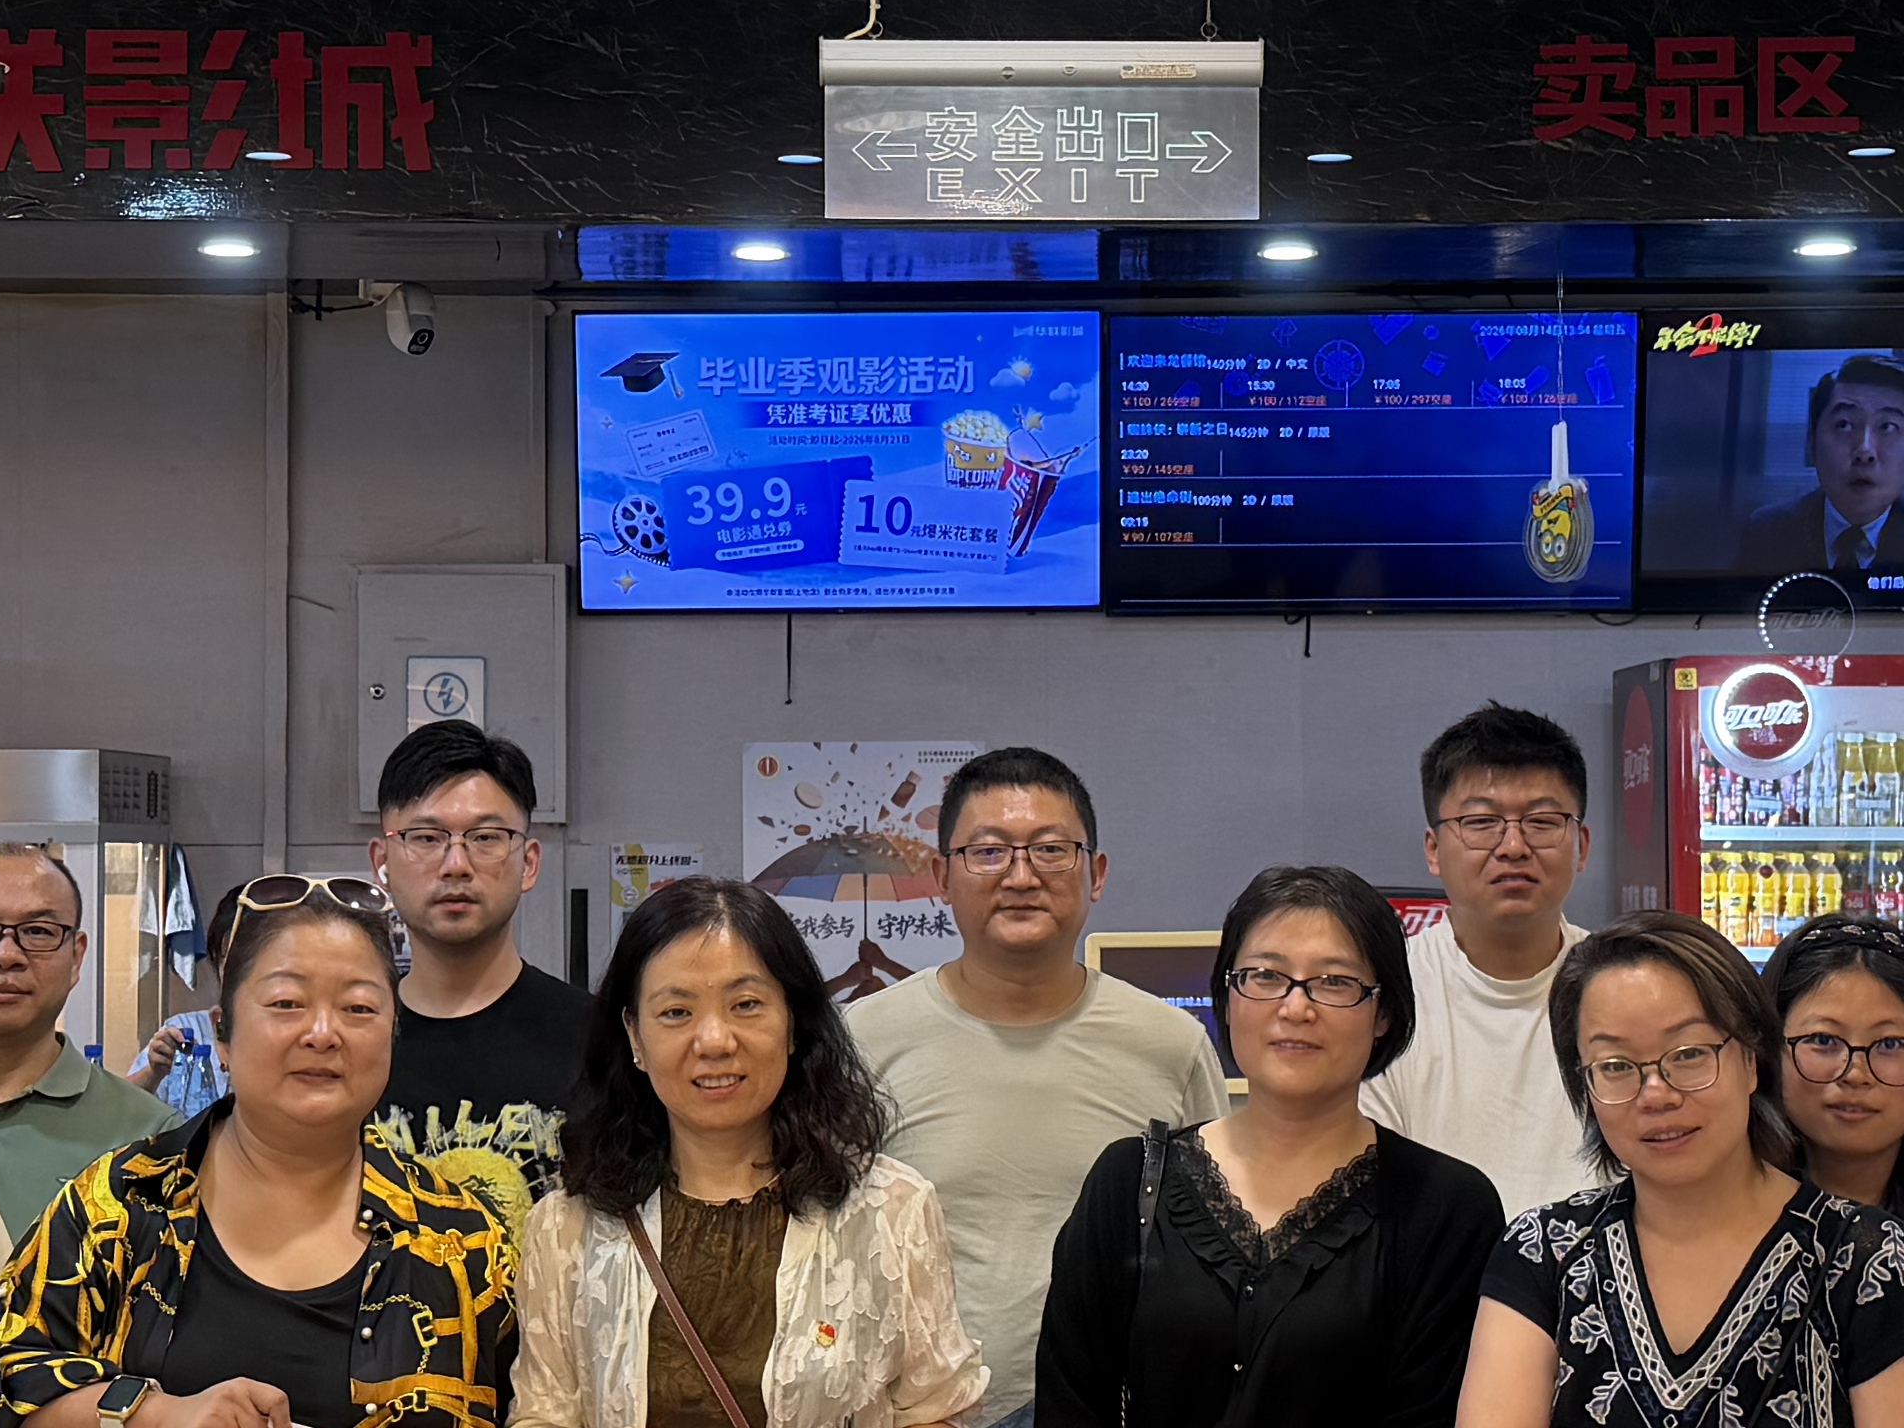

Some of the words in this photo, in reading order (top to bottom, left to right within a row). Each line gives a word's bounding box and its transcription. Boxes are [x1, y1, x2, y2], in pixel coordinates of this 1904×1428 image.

[1533, 36, 1860, 141] 卖品区
[925, 106, 1159, 162] 安全出口
[927, 168, 1159, 203] EXIT
[698, 355, 974, 397] 毕业季观影活动
[767, 403, 912, 425] 凭准考证享优惠
[717, 522, 792, 544] 电影通兑券
[1724, 699, 1806, 730] 可口可乐
[877, 910, 959, 941] 守护未来
